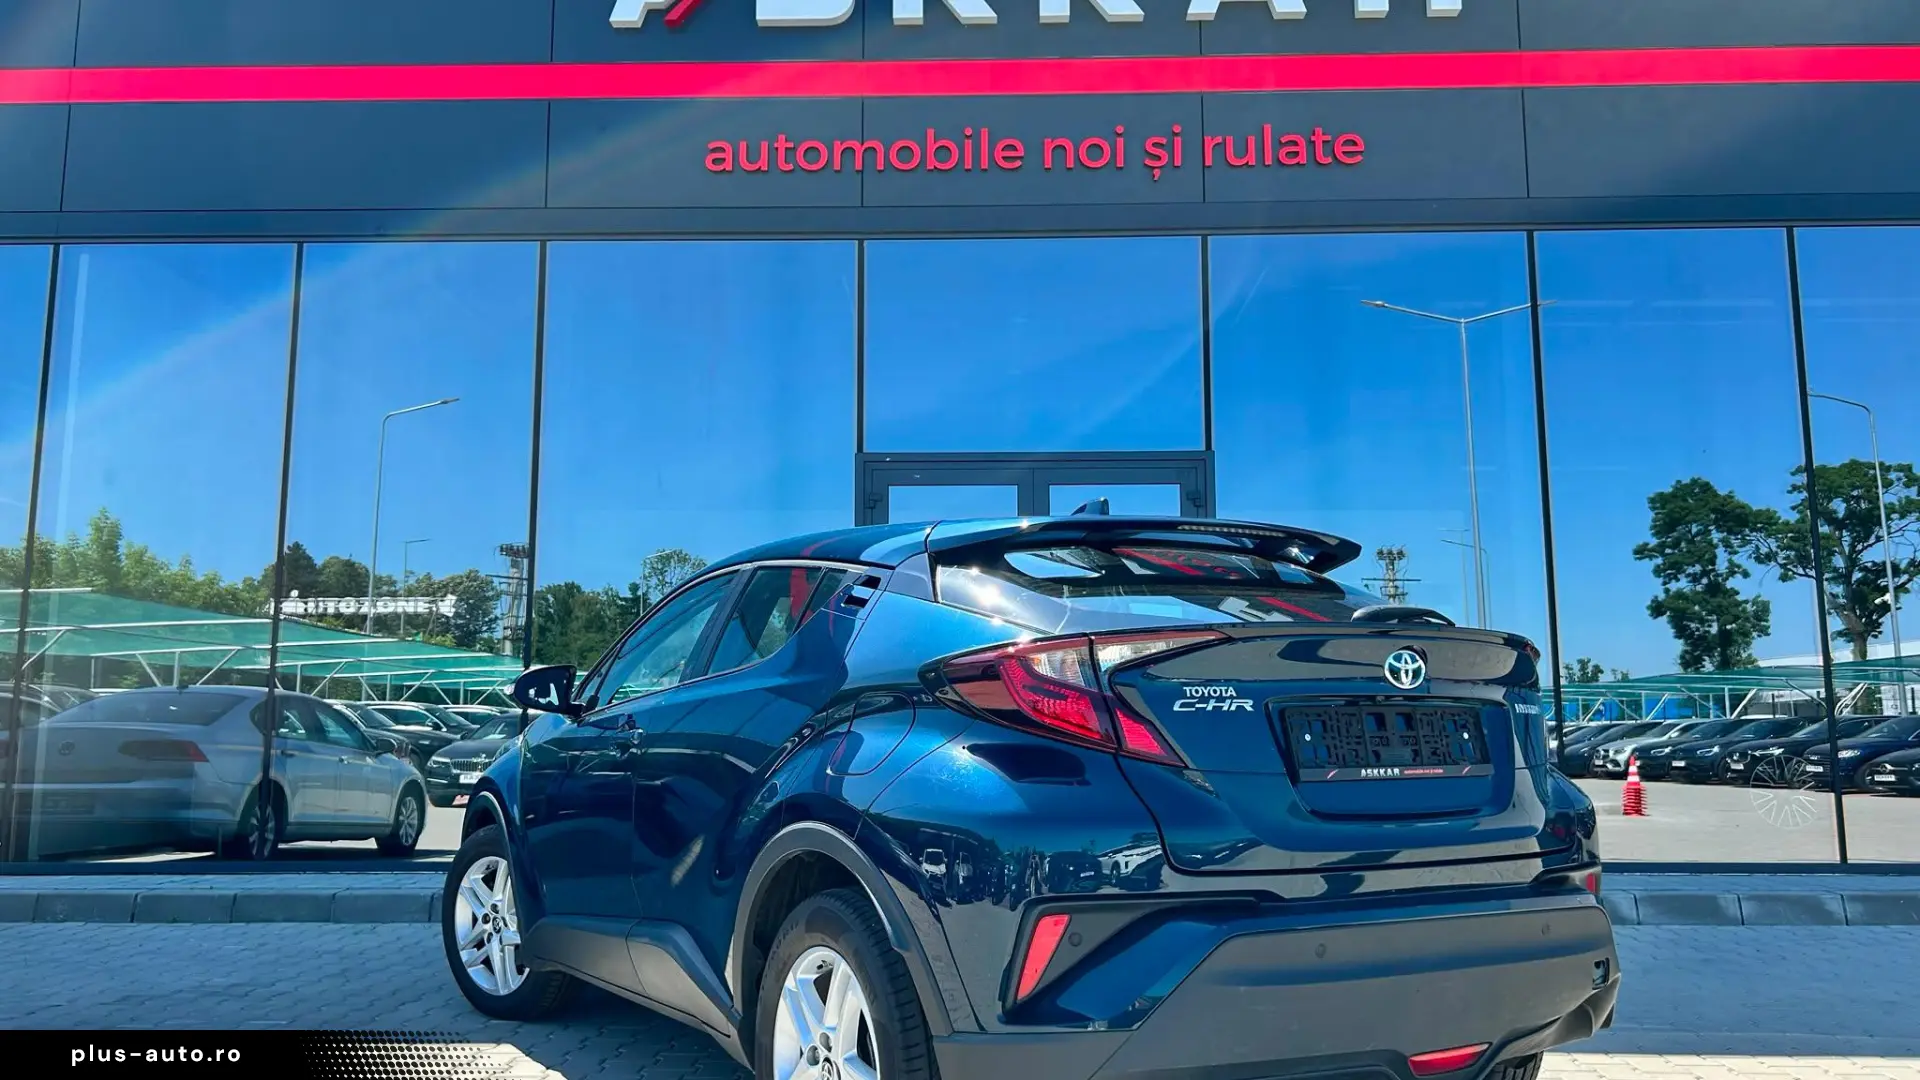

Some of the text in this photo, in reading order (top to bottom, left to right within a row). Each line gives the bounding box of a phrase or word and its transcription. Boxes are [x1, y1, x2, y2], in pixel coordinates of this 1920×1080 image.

[704, 123, 1366, 181] automobile noi și rulate
[1183, 686, 1237, 697] TOYOTA
[1173, 698, 1255, 712] C-HR
[1360, 767, 1401, 778] ASKKAR
